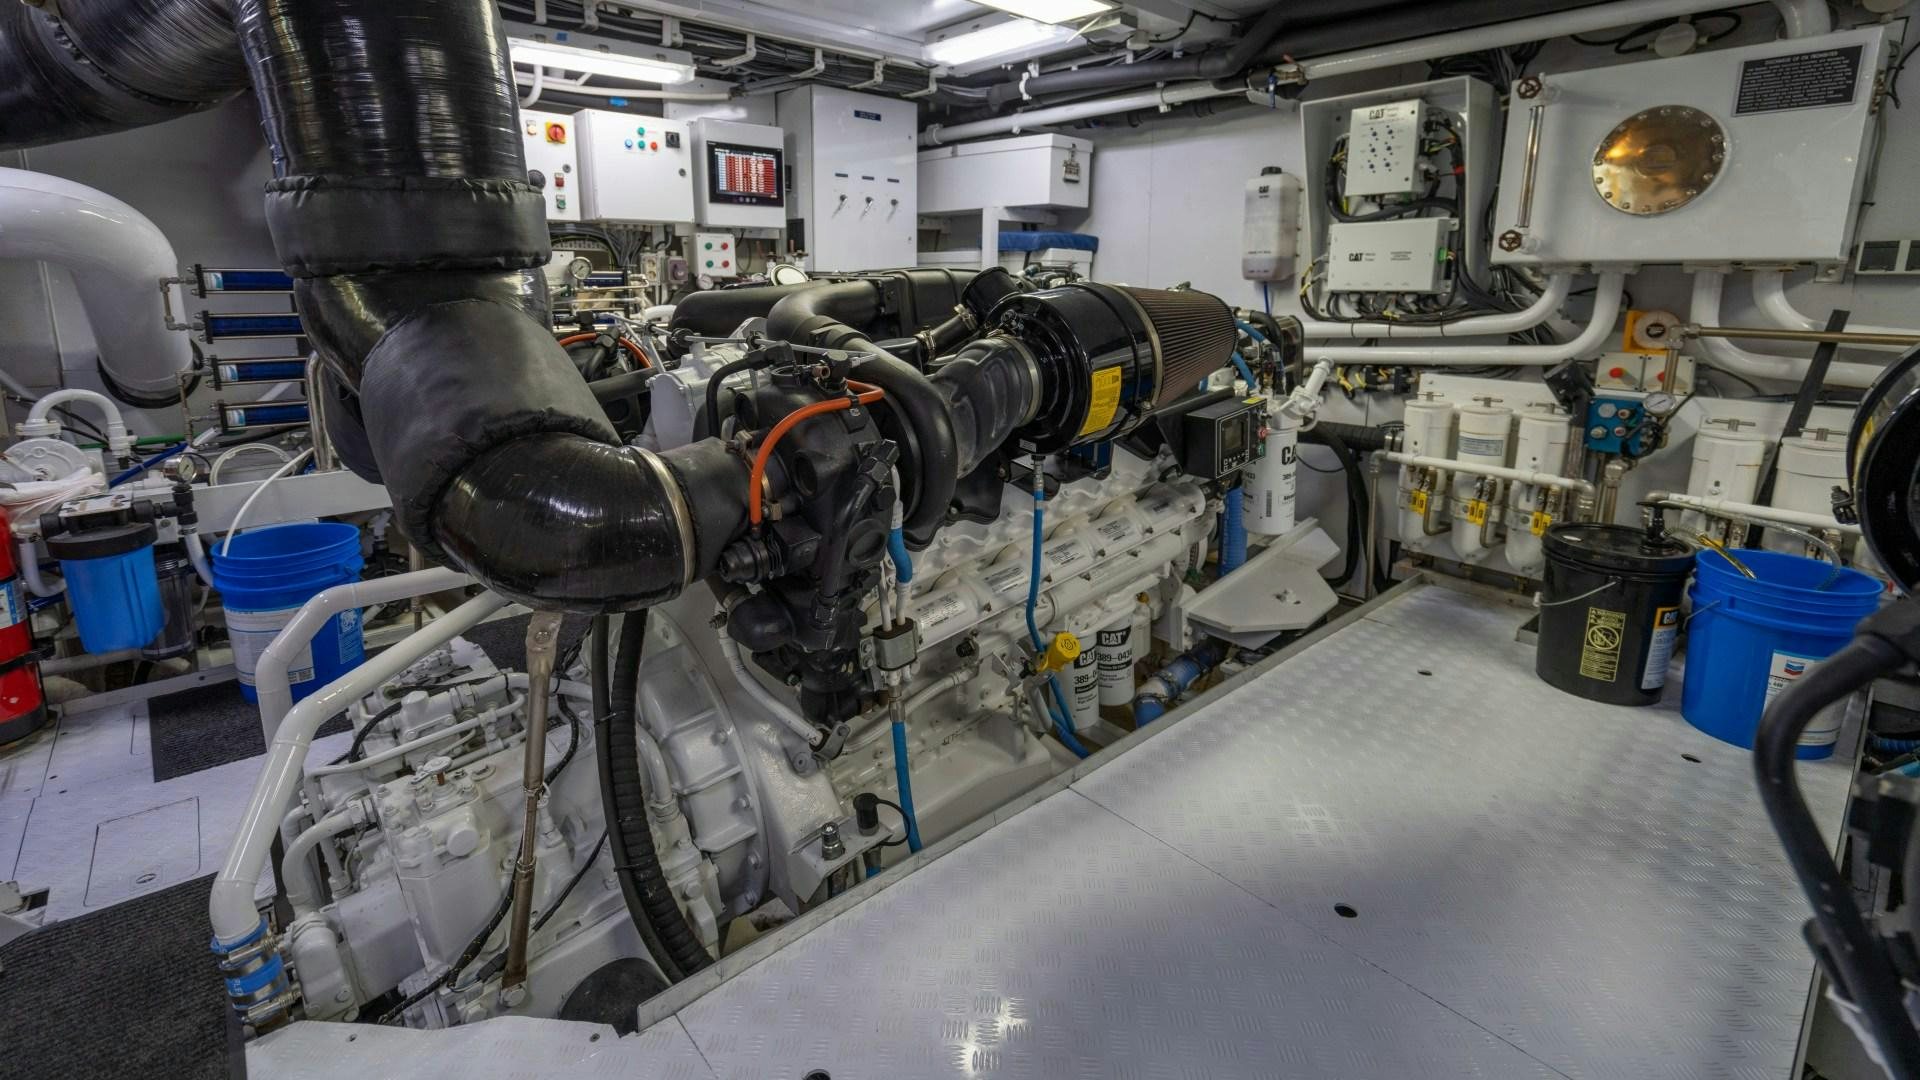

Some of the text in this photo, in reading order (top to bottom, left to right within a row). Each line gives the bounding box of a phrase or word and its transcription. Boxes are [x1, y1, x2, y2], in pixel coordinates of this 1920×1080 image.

[1348, 253, 1363, 262] CAT
[1281, 445, 1297, 466] CA
[1101, 632, 1122, 645] CAT
